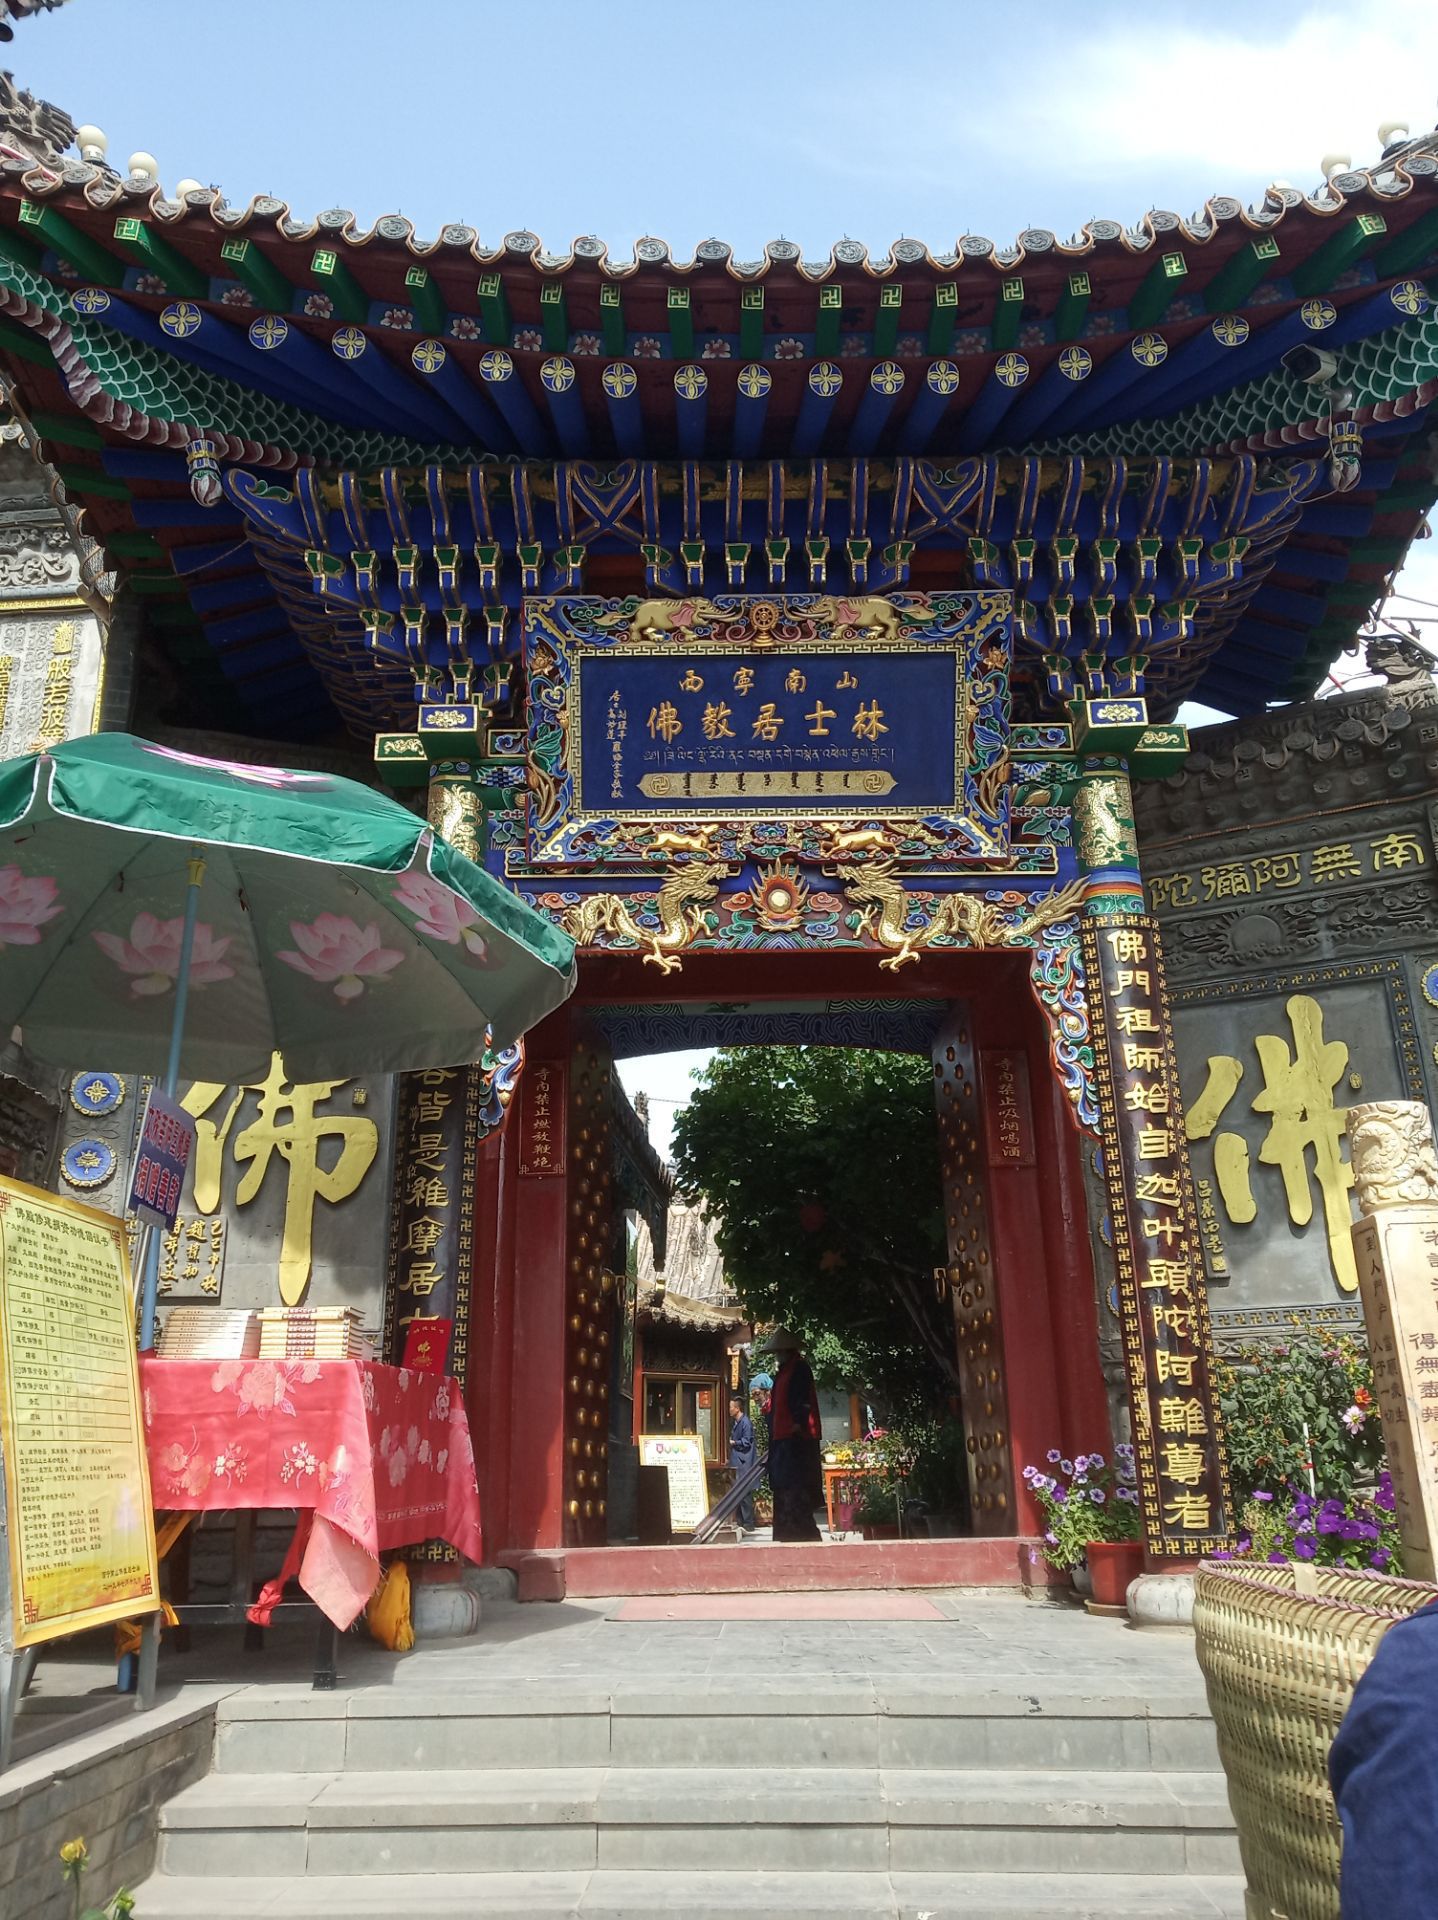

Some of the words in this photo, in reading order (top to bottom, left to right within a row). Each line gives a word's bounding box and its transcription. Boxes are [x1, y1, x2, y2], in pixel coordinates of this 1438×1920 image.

[646, 698, 890, 744] 佛教居士林
